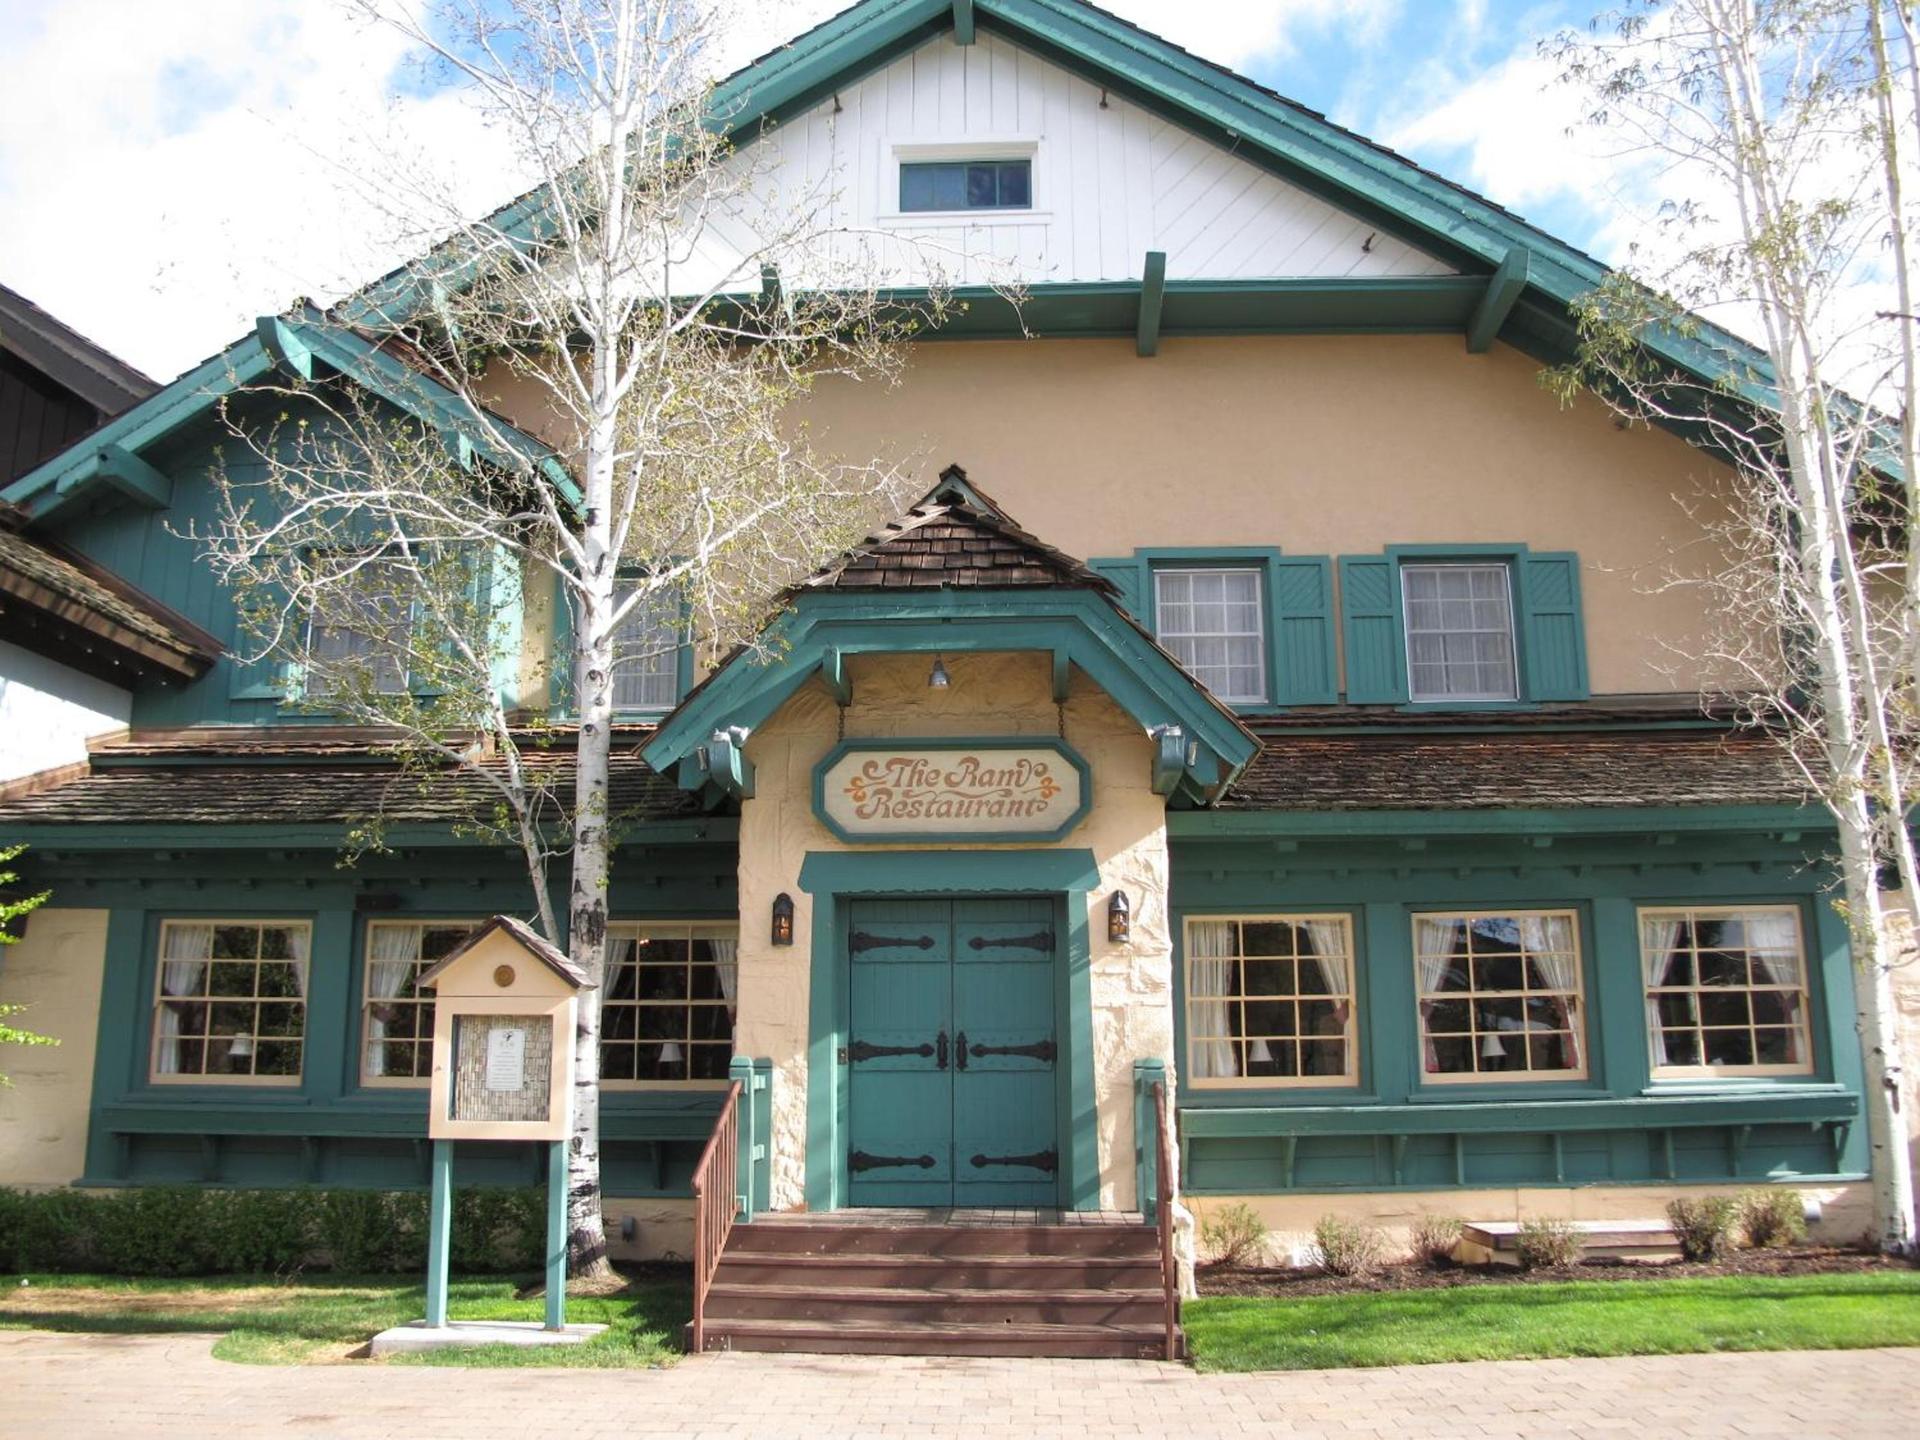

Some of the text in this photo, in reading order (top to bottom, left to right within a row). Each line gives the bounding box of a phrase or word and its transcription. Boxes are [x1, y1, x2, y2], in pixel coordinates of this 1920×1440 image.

[862, 756, 1048, 788] The Ram
[855, 788, 1048, 820] Restaurant
